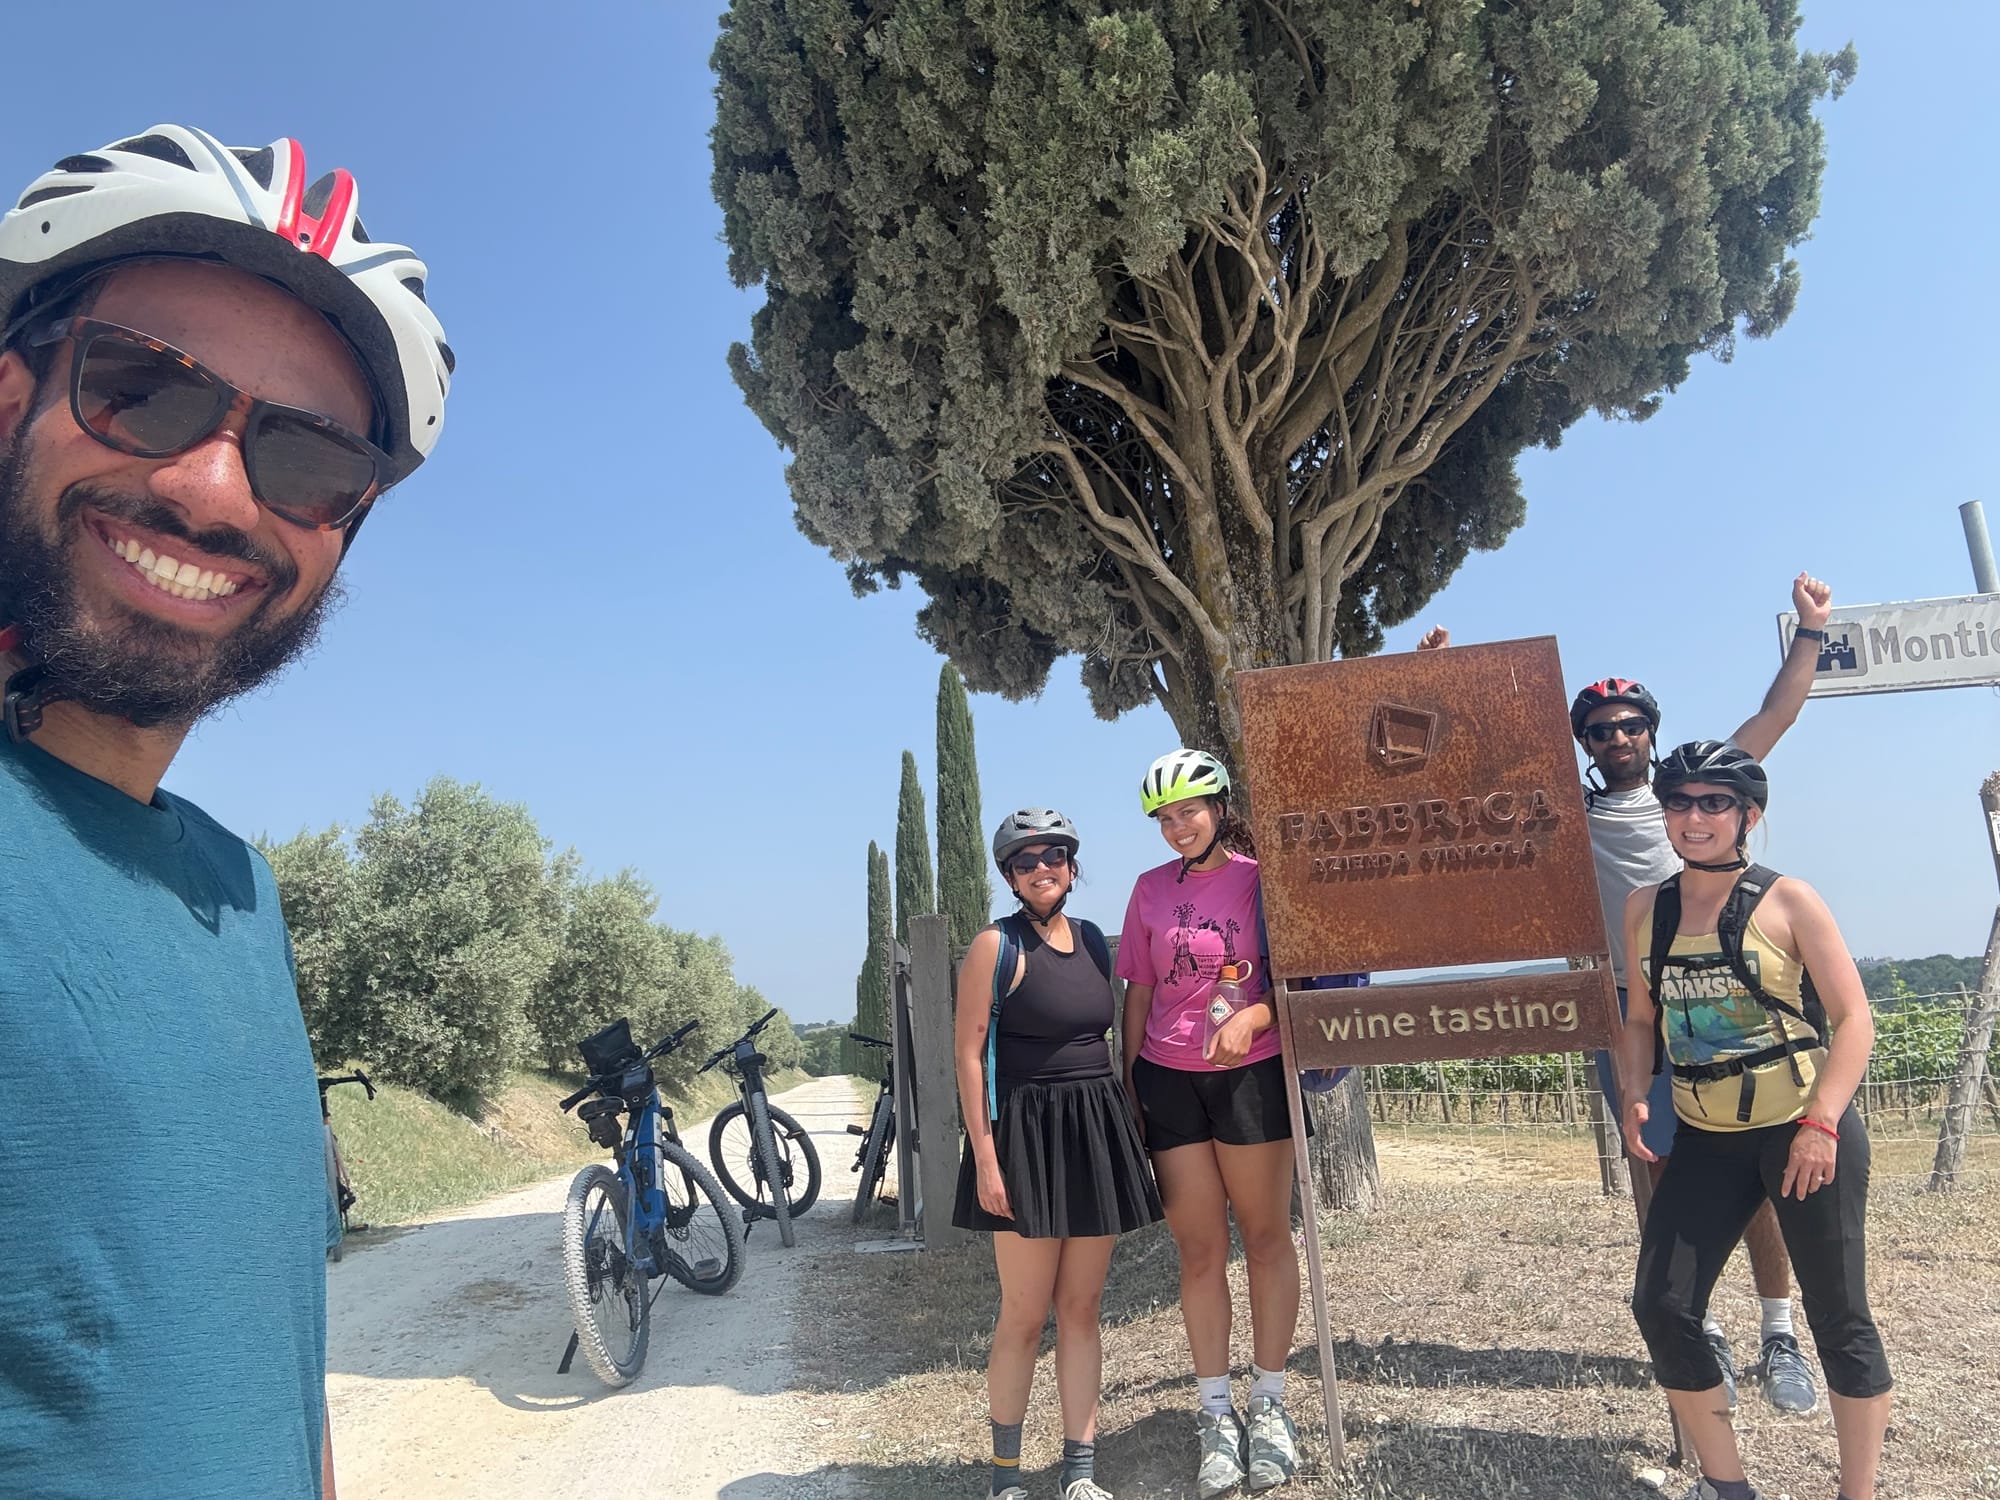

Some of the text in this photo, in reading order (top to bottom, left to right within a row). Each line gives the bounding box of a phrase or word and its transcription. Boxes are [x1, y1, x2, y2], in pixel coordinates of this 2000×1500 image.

[1278, 789, 1553, 843] FABBRICA
[1311, 839, 1538, 875] AZIENDA VINICOLA
[1660, 976, 1729, 1000] ARKS
[1318, 995, 1579, 1041] wine tasting
